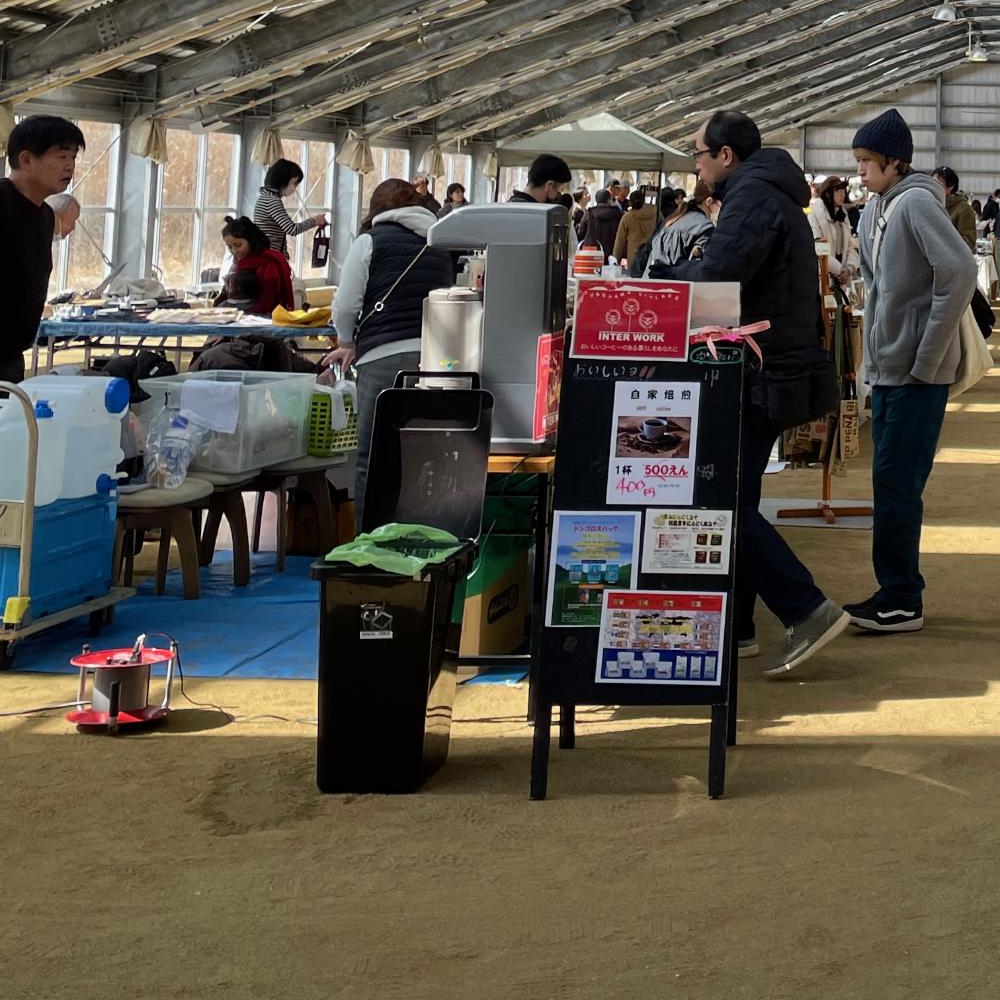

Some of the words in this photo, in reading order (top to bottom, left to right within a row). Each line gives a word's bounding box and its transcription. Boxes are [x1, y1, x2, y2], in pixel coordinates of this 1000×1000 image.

[598, 332, 630, 342] INTER
[633, 333, 665, 343] WORK
[630, 389, 692, 400] 自家焙煎
[615, 464, 632, 476] 1杯
[645, 464, 689, 476] 500えん
[616, 477, 656, 497] 400円
